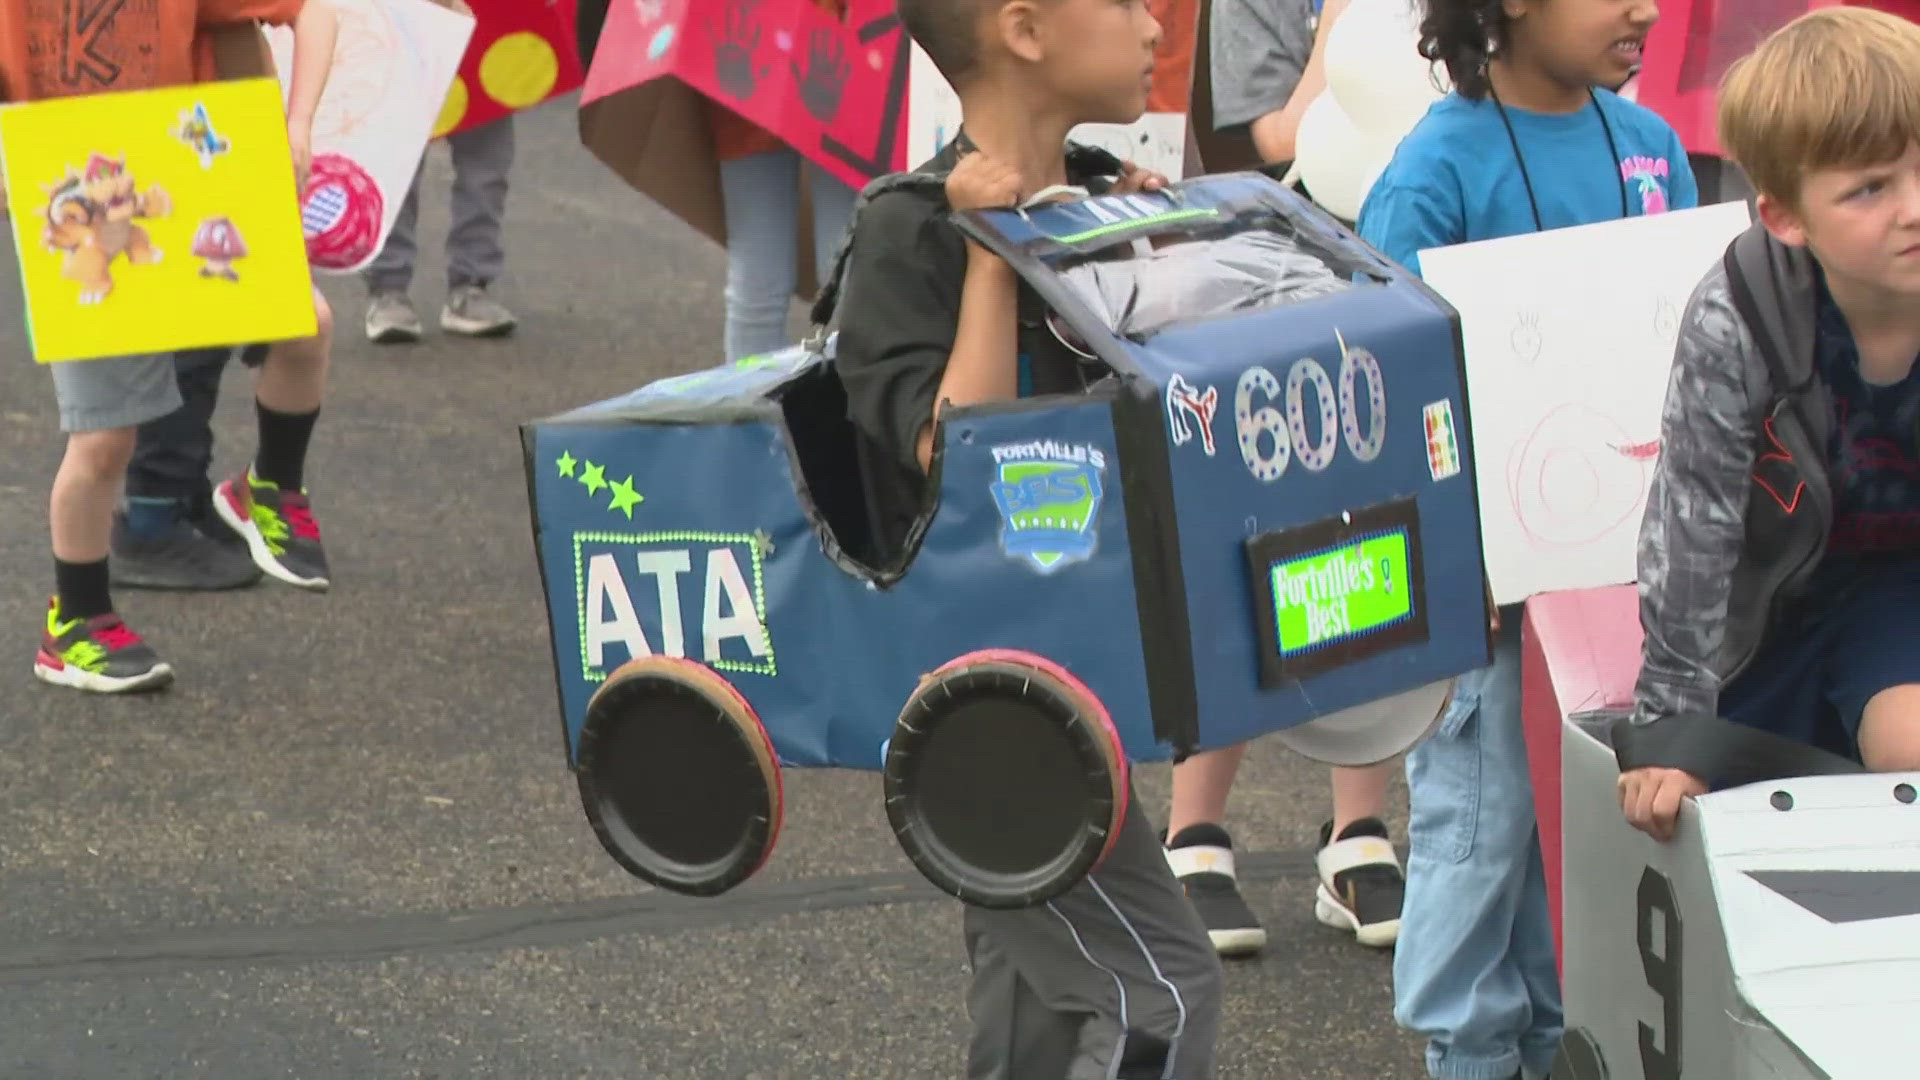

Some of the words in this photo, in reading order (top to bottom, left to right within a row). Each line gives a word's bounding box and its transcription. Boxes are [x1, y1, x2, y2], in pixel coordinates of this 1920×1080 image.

[1082, 194, 1165, 224] ATA
[1235, 347, 1386, 481] 600
[991, 439, 1106, 468] FORTVILLE'S
[585, 548, 773, 666] ATA
[1273, 542, 1375, 609] Fortville's
[1306, 598, 1350, 644] Best
[1637, 864, 1683, 1080] 9
